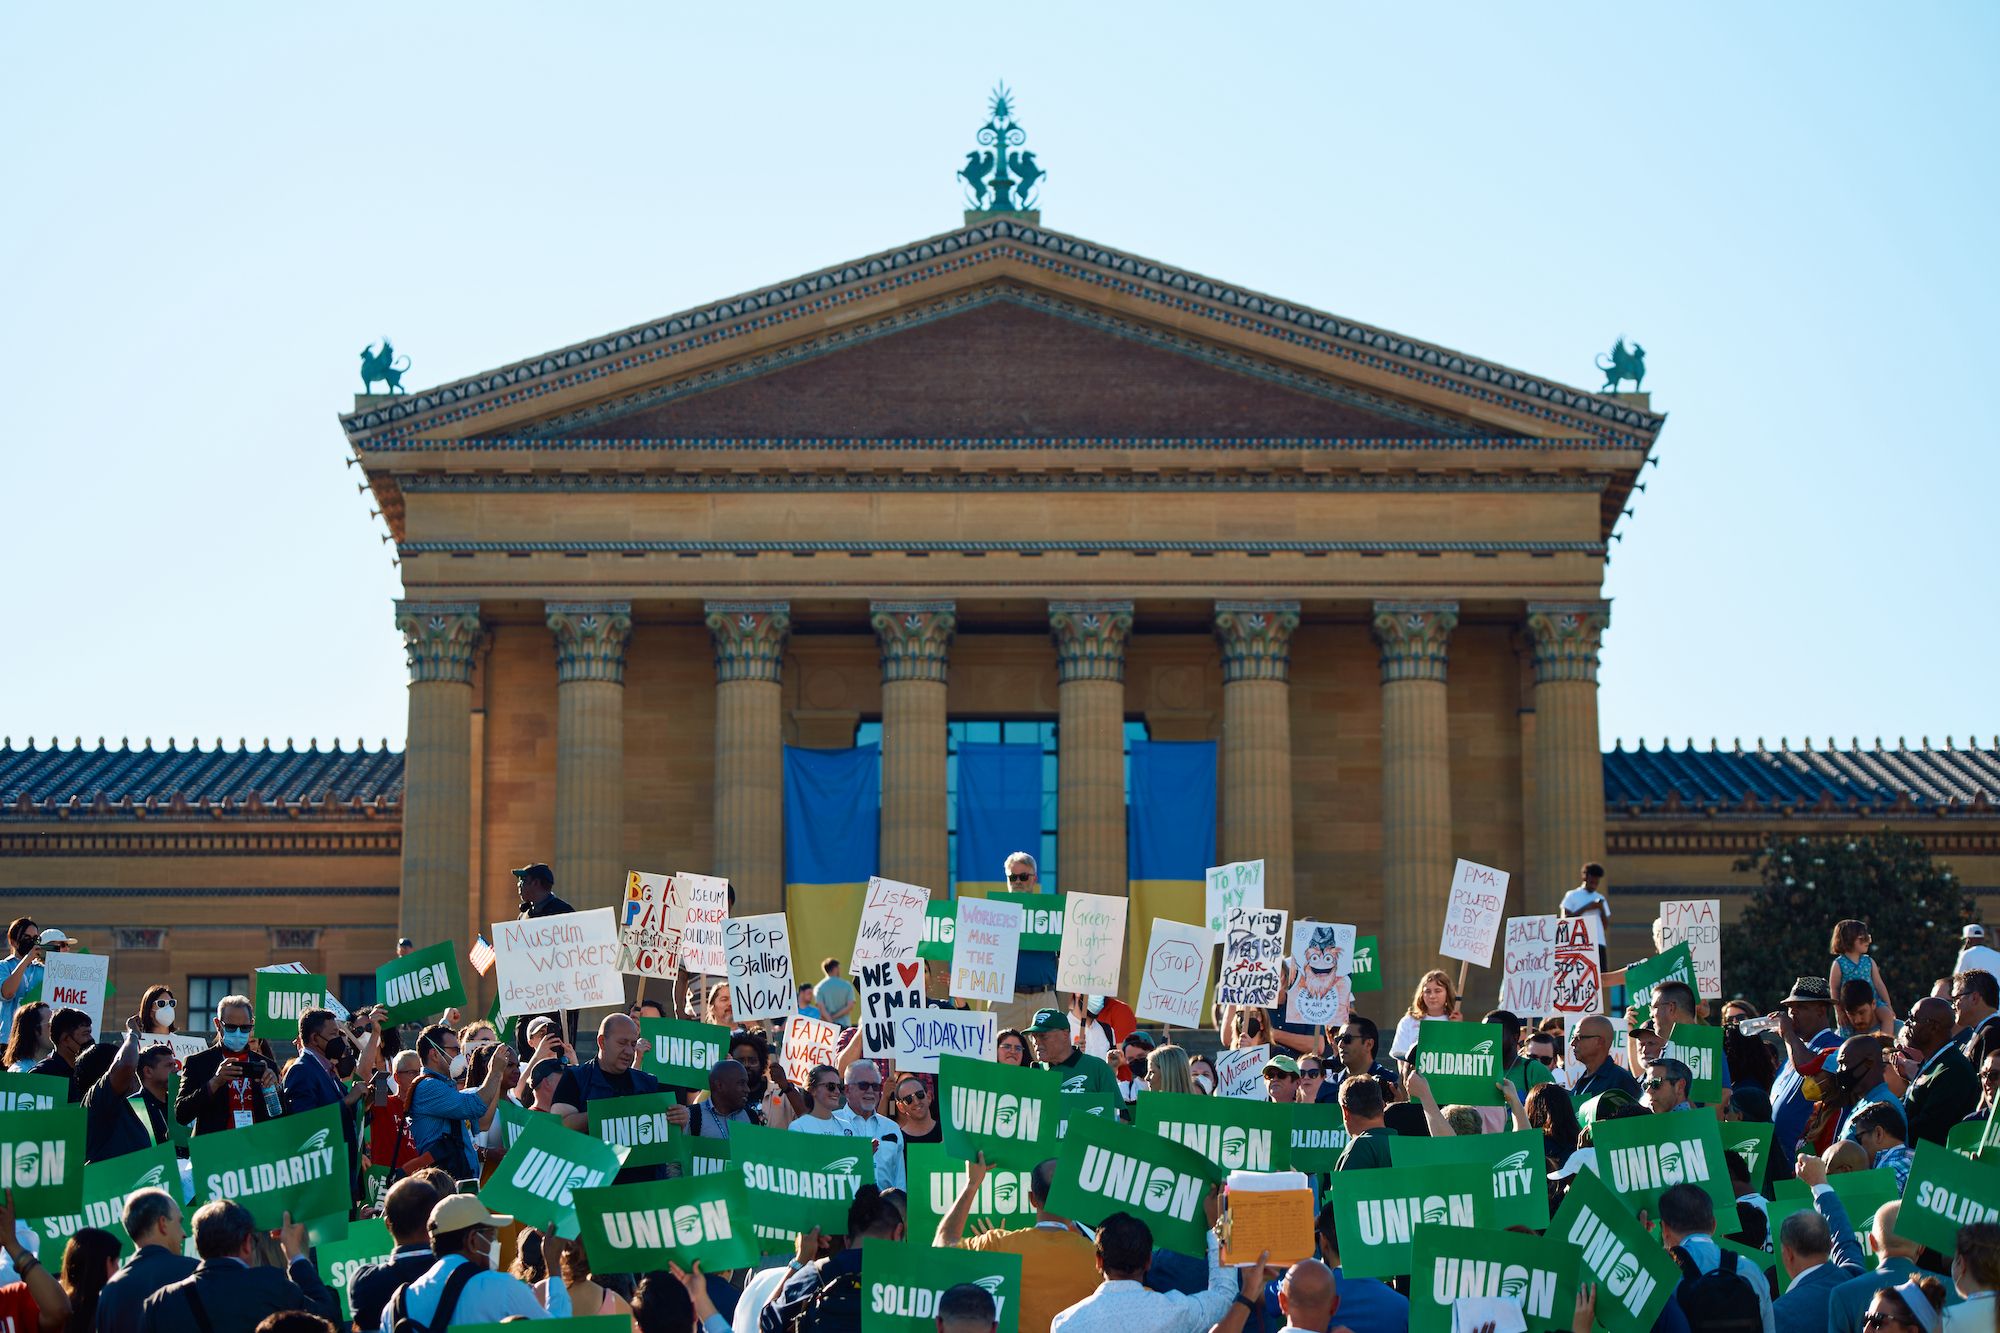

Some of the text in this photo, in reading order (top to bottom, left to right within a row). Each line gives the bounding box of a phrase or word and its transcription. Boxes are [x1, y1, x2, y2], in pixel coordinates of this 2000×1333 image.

[1235, 865, 1261, 886] PAY
[662, 877, 684, 909] A
[869, 883, 923, 912] Listen
[1223, 887, 1245, 909] MY
[1453, 889, 1501, 912] POWERED
[620, 900, 682, 936] PAL
[686, 907, 727, 924] ORKERS
[884, 907, 904, 927] to
[962, 904, 1018, 929] WORKERS
[1463, 908, 1482, 924] BY
[1666, 902, 1715, 925] PMA
[505, 924, 584, 952] Museum
[682, 926, 723, 947] OLIDARIT
[726, 923, 784, 950] Stop
[861, 920, 901, 942] What
[920, 916, 955, 943] NIO
[968, 929, 1000, 946] MAKE
[1076, 928, 1113, 954] light
[1446, 924, 1490, 942] MUSEUM
[1508, 919, 1552, 944] FAIR
[1555, 919, 1590, 946] MA
[1662, 926, 1720, 948] POWERED
[526, 944, 617, 973] Workers
[682, 947, 706, 967] PMA
[966, 950, 995, 965] THE
[1068, 952, 1106, 967] our
[1155, 952, 1195, 972] STOP
[1449, 940, 1489, 958] WORKERS
[1506, 947, 1553, 974] Contract
[47, 960, 104, 983] WORKERS
[730, 952, 788, 979] Stalling
[862, 962, 893, 987] WE
[385, 962, 451, 1007] UNION
[504, 971, 601, 1001] deserve fair
[957, 967, 1006, 995] PMA!
[53, 986, 87, 1005] MAKE
[525, 989, 604, 1011] wages now
[867, 990, 921, 1018] PMA
[1143, 992, 1199, 1021] STALLING
[1505, 977, 1553, 1013] NOW!
[1306, 1008, 1328, 1018] UNION
[791, 1018, 833, 1046] FAIR
[902, 1017, 993, 1055] SOLIDARITY!
[655, 1034, 720, 1071] UNION
[785, 1045, 833, 1067] WAGES
[1419, 1051, 1494, 1077] SOLIDARITY
[788, 1064, 811, 1082] NO
[1220, 1053, 1264, 1092] Museum
[0, 1091, 54, 1112] ION
[951, 1086, 1042, 1142] UNION
[601, 1112, 670, 1147] UNION
[1291, 1129, 1351, 1149] OLIDARI
[207, 1146, 334, 1201] SOLIDARITY
[1610, 1138, 1710, 1194] UNION
[743, 1161, 862, 1201] SOLIDARITY
[1078, 1145, 1203, 1222] UNION
[601, 1199, 733, 1249] UNION
[1357, 1195, 1475, 1245] UNION
[1568, 1204, 1657, 1318] UNION
[1433, 1257, 1558, 1319] UNION
